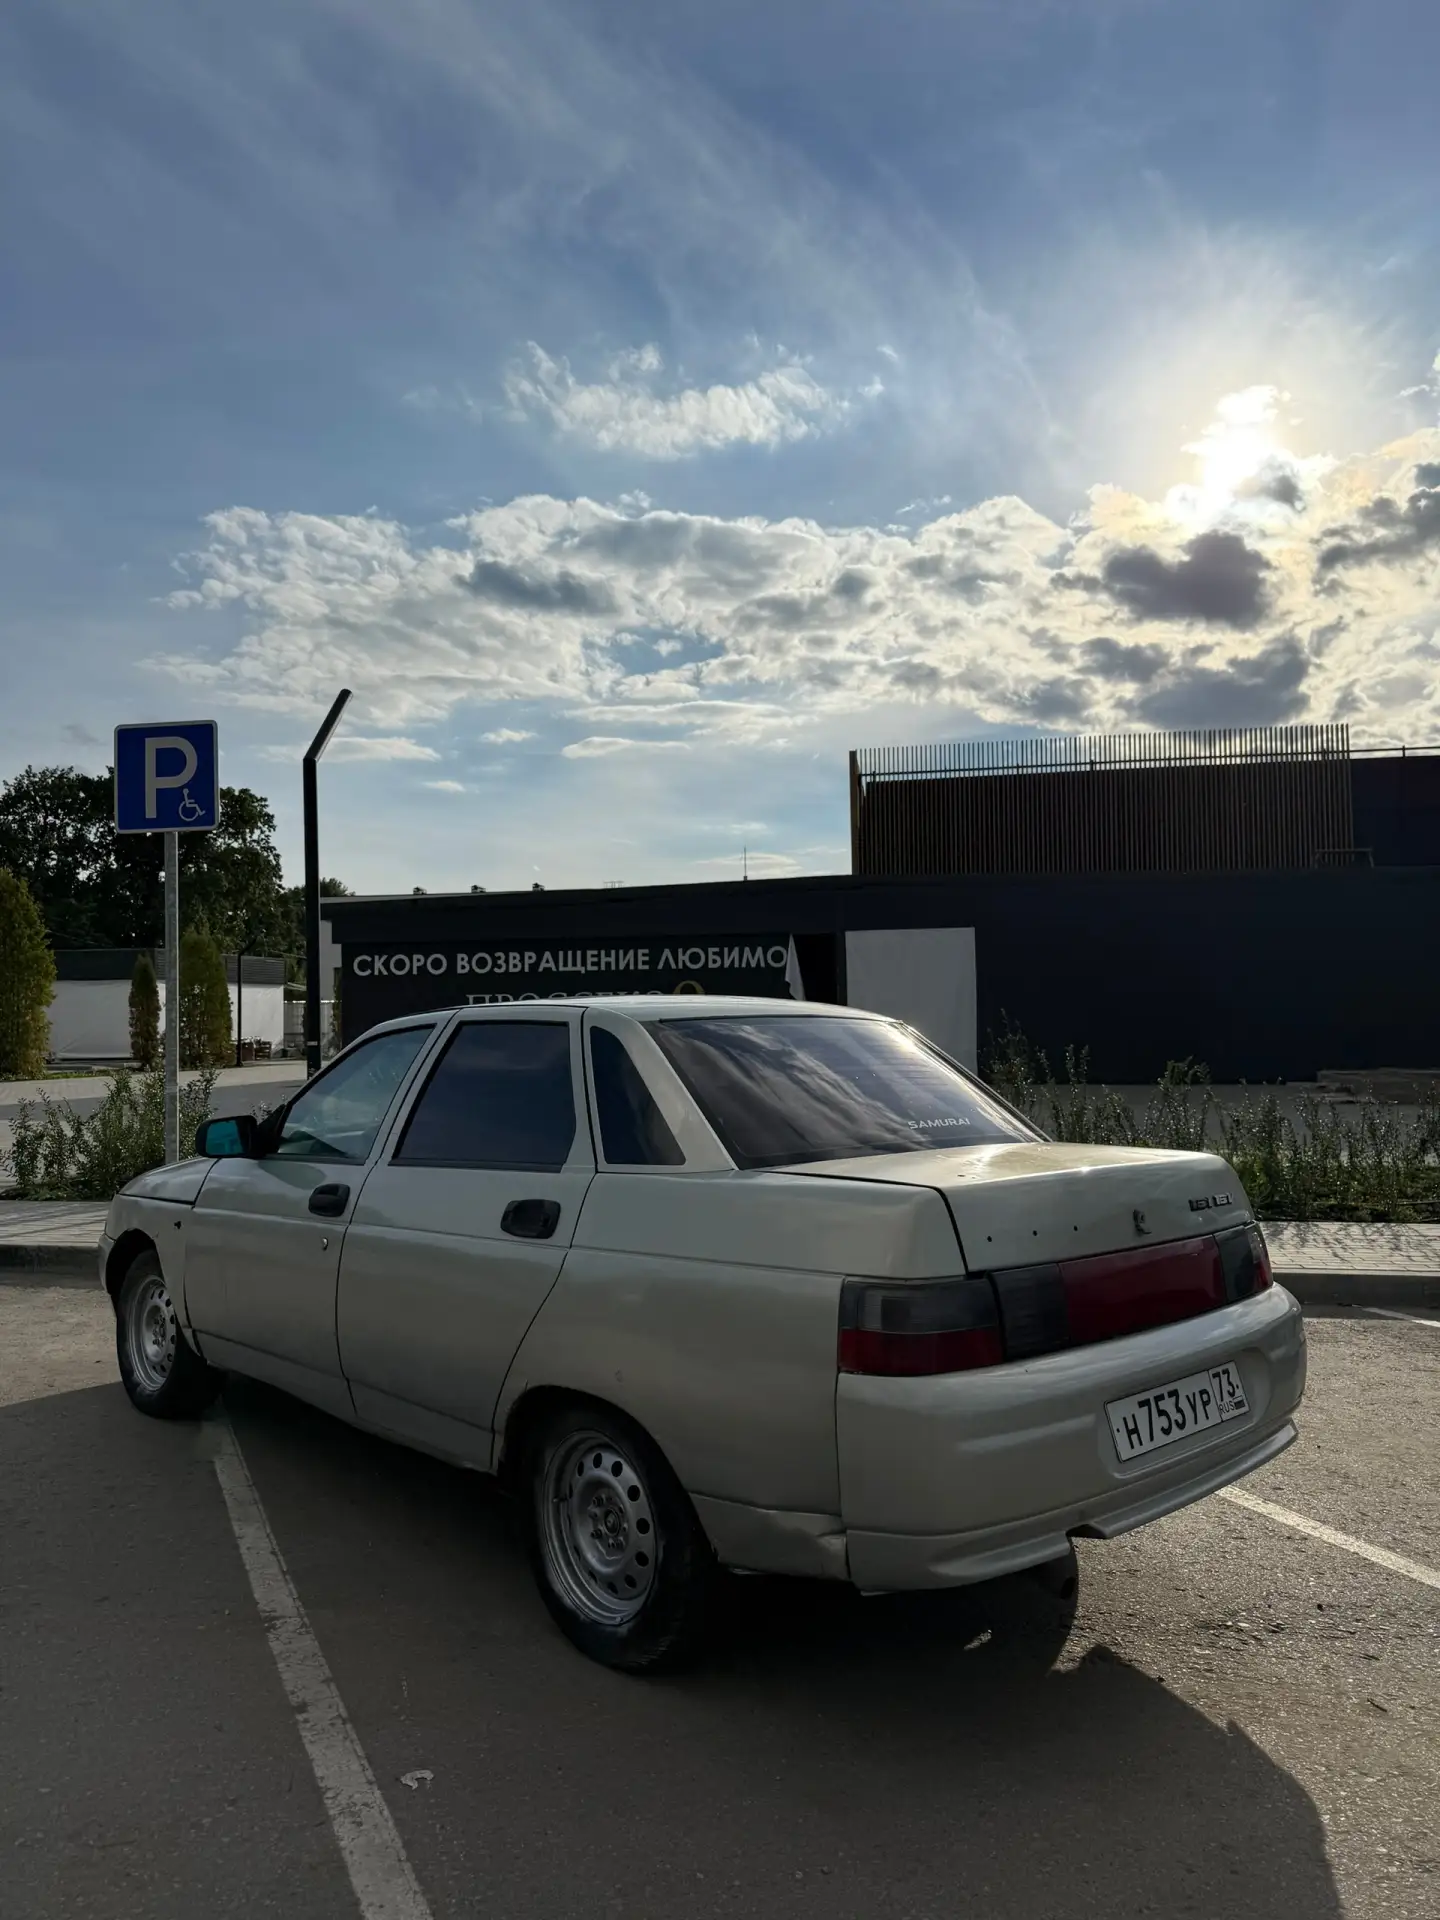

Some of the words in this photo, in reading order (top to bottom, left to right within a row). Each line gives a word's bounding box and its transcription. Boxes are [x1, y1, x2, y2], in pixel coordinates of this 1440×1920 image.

[144, 736, 198, 819] P
[353, 953, 448, 977] СКОРО
[456, 948, 650, 974] ВОЗВРАЩЕНИЕ
[908, 1117, 971, 1130] SAMURAI
[1211, 1367, 1236, 1402] 73
[1218, 1401, 1235, 1416] RUS
